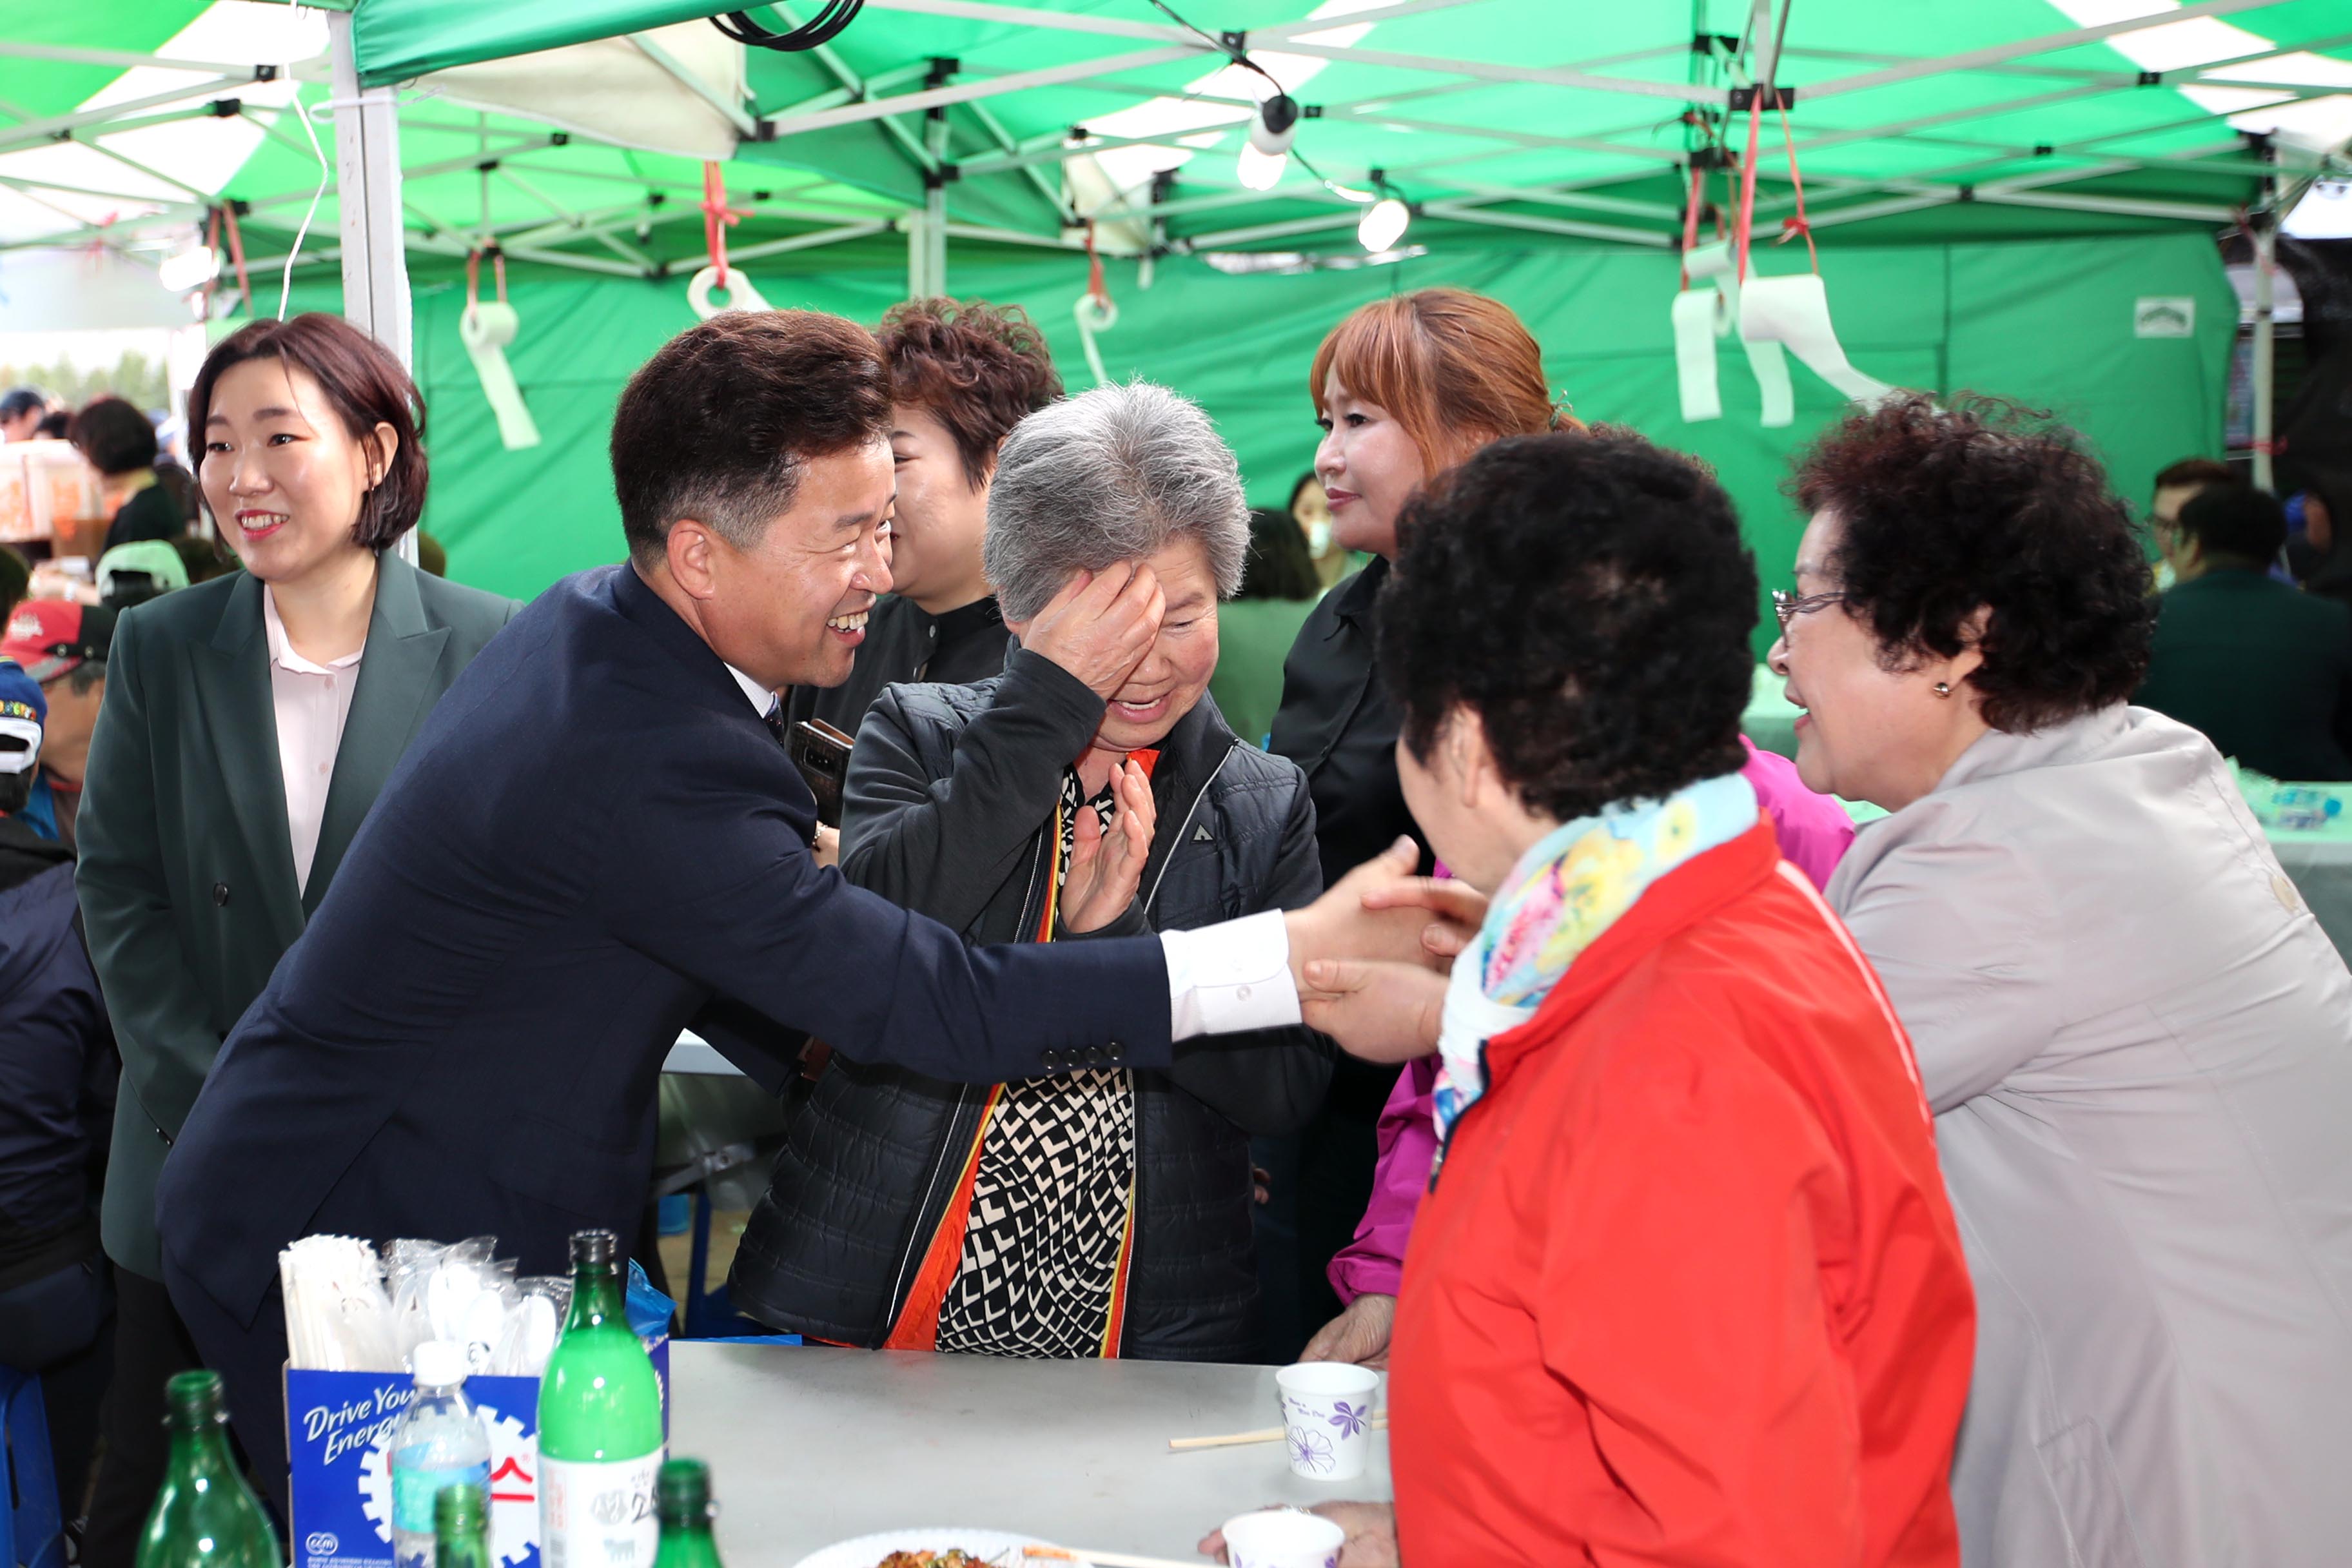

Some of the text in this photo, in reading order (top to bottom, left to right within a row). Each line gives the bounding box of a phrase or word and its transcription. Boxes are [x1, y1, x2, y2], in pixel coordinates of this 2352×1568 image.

[303, 1383, 416, 1443] Drive You
[324, 1413, 400, 1467] Energ
